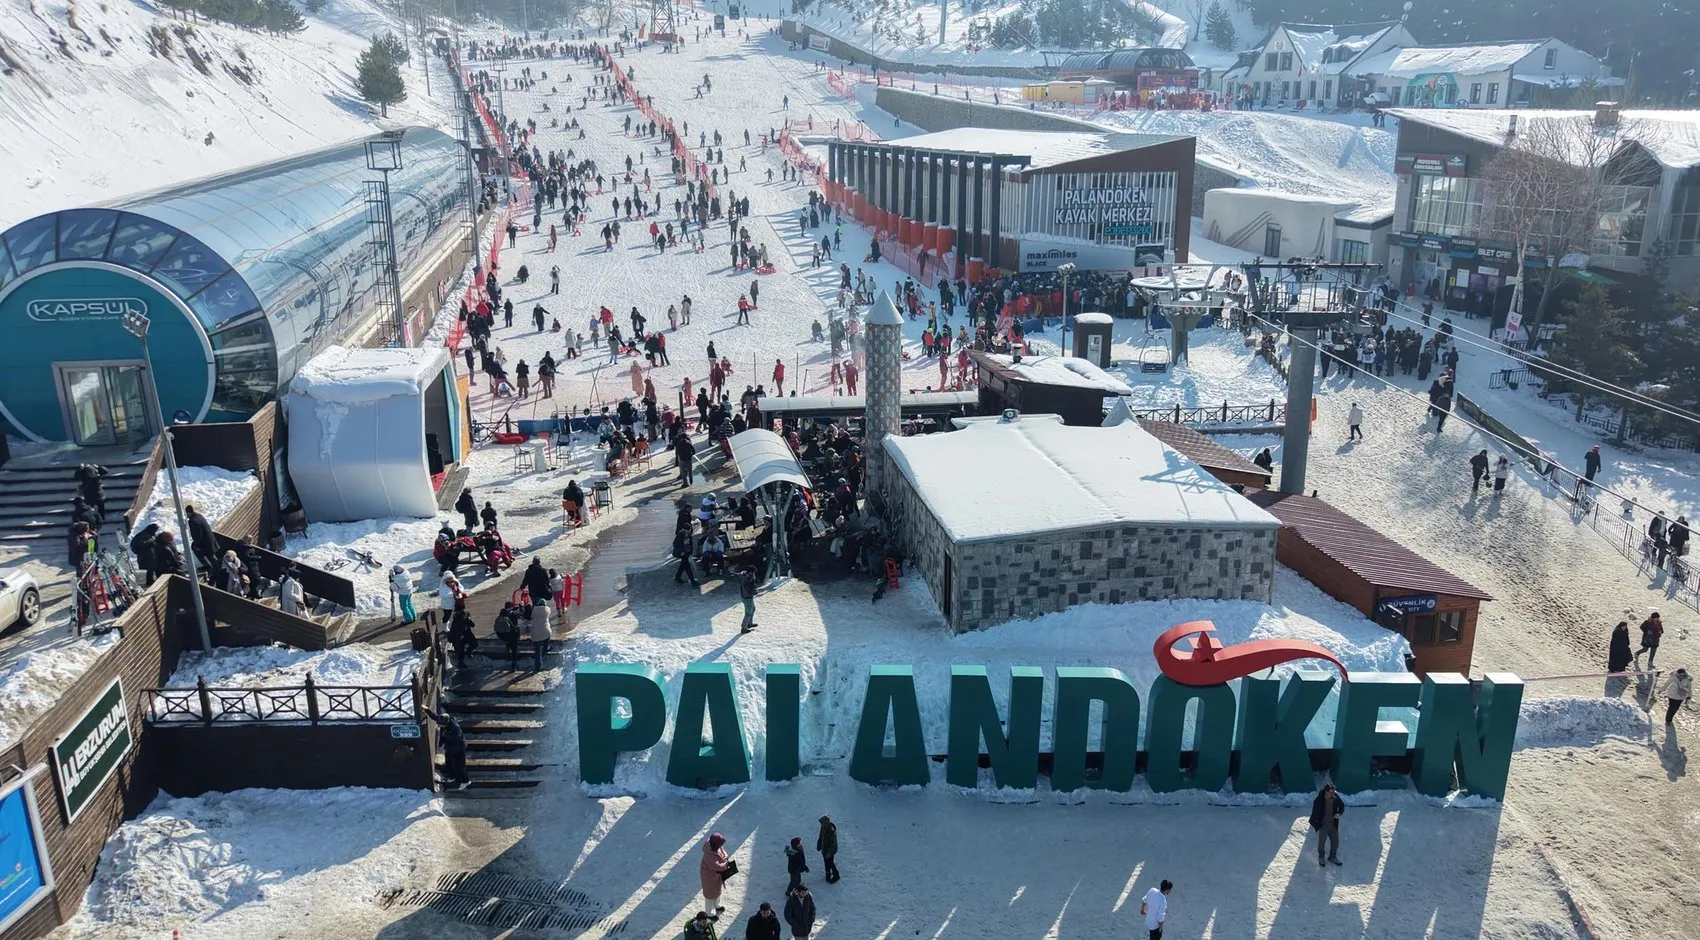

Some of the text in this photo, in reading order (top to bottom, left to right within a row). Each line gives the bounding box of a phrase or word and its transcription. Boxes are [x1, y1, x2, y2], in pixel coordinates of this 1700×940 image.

[1064, 185, 1147, 205] PALANDÖKEN
[1055, 208, 1096, 224] KAYAK
[1027, 249, 1078, 259] maximiles
[74, 699, 126, 770] ERZURUM
